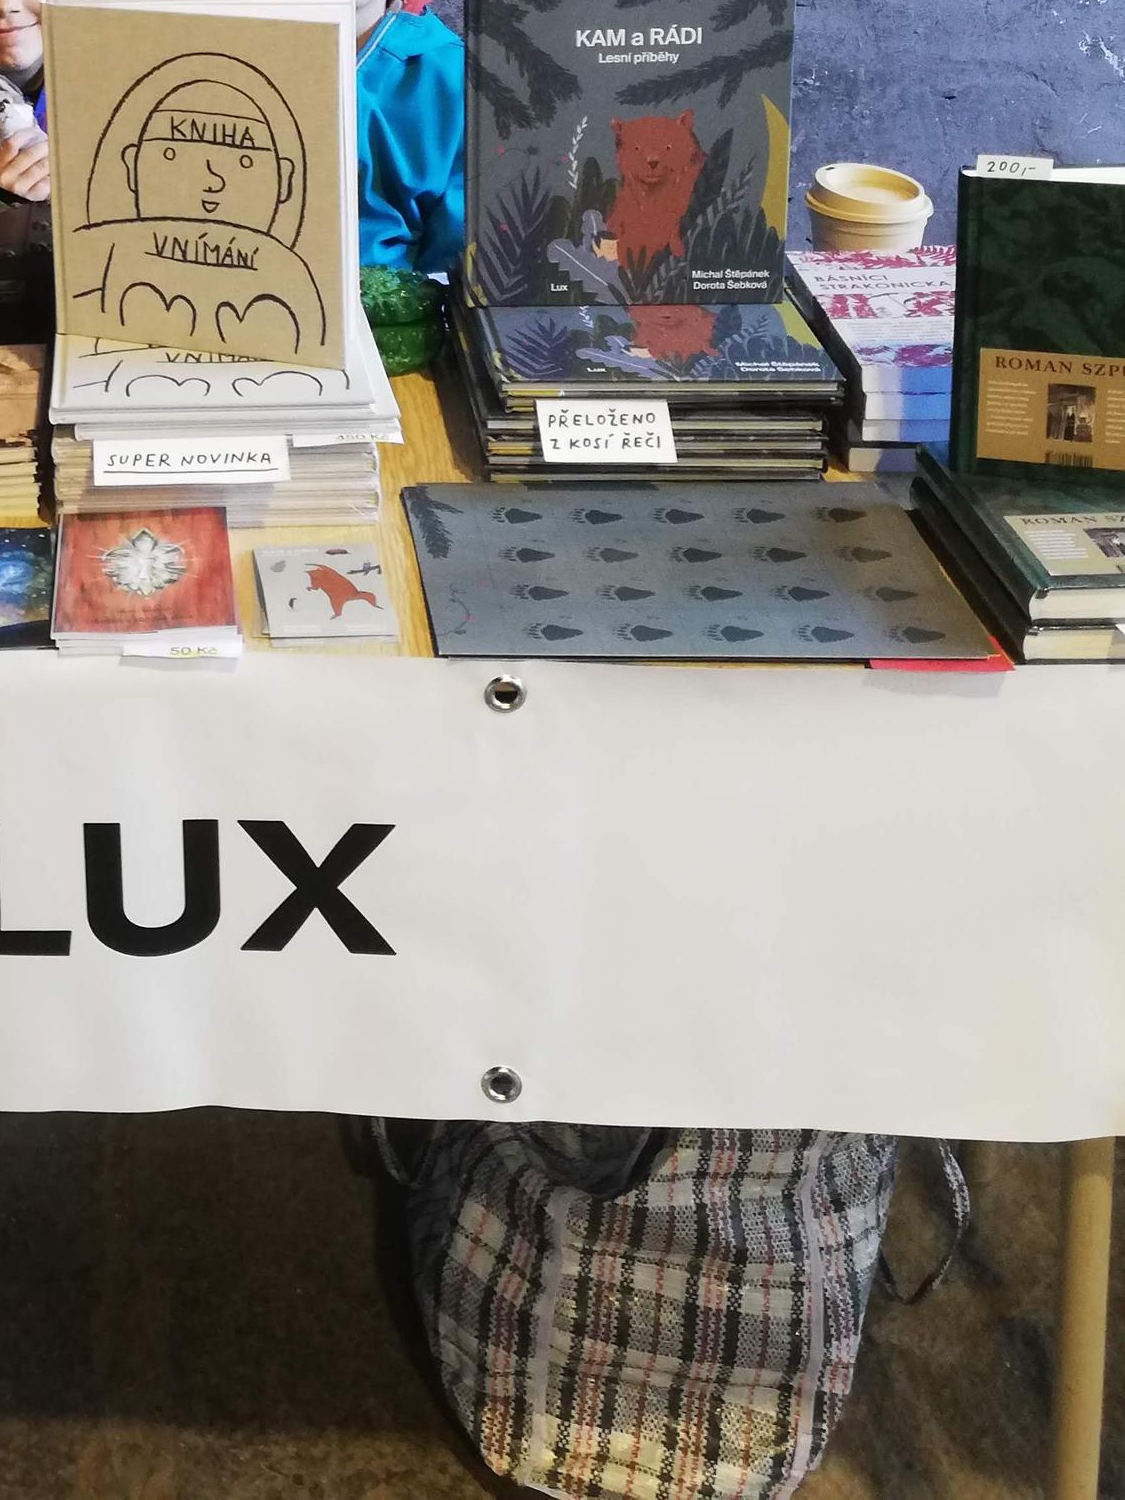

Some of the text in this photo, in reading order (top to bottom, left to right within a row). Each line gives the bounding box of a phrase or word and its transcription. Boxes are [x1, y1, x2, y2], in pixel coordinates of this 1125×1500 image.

[575, 24, 703, 48] KAM a RÁDI
[598, 51, 679, 65] Lesní příběhy
[169, 115, 258, 148] KNIHA
[152, 232, 260, 269] VNÍMÁNÍ
[691, 268, 770, 280] Michal Štěpánek
[814, 273, 889, 283] BÁSNÍCI
[550, 282, 569, 292] Lux
[693, 279, 768, 290] Dorota Šebková
[819, 280, 951, 290] STRAKONICKA
[995, 355, 1125, 377] ROMAN SZP
[548, 409, 656, 429] PŘELOŽENO
[569, 433, 614, 449] KOSÍ
[621, 431, 661, 449] ŘEČI
[106, 451, 272, 468] SUPER NOVINKA
